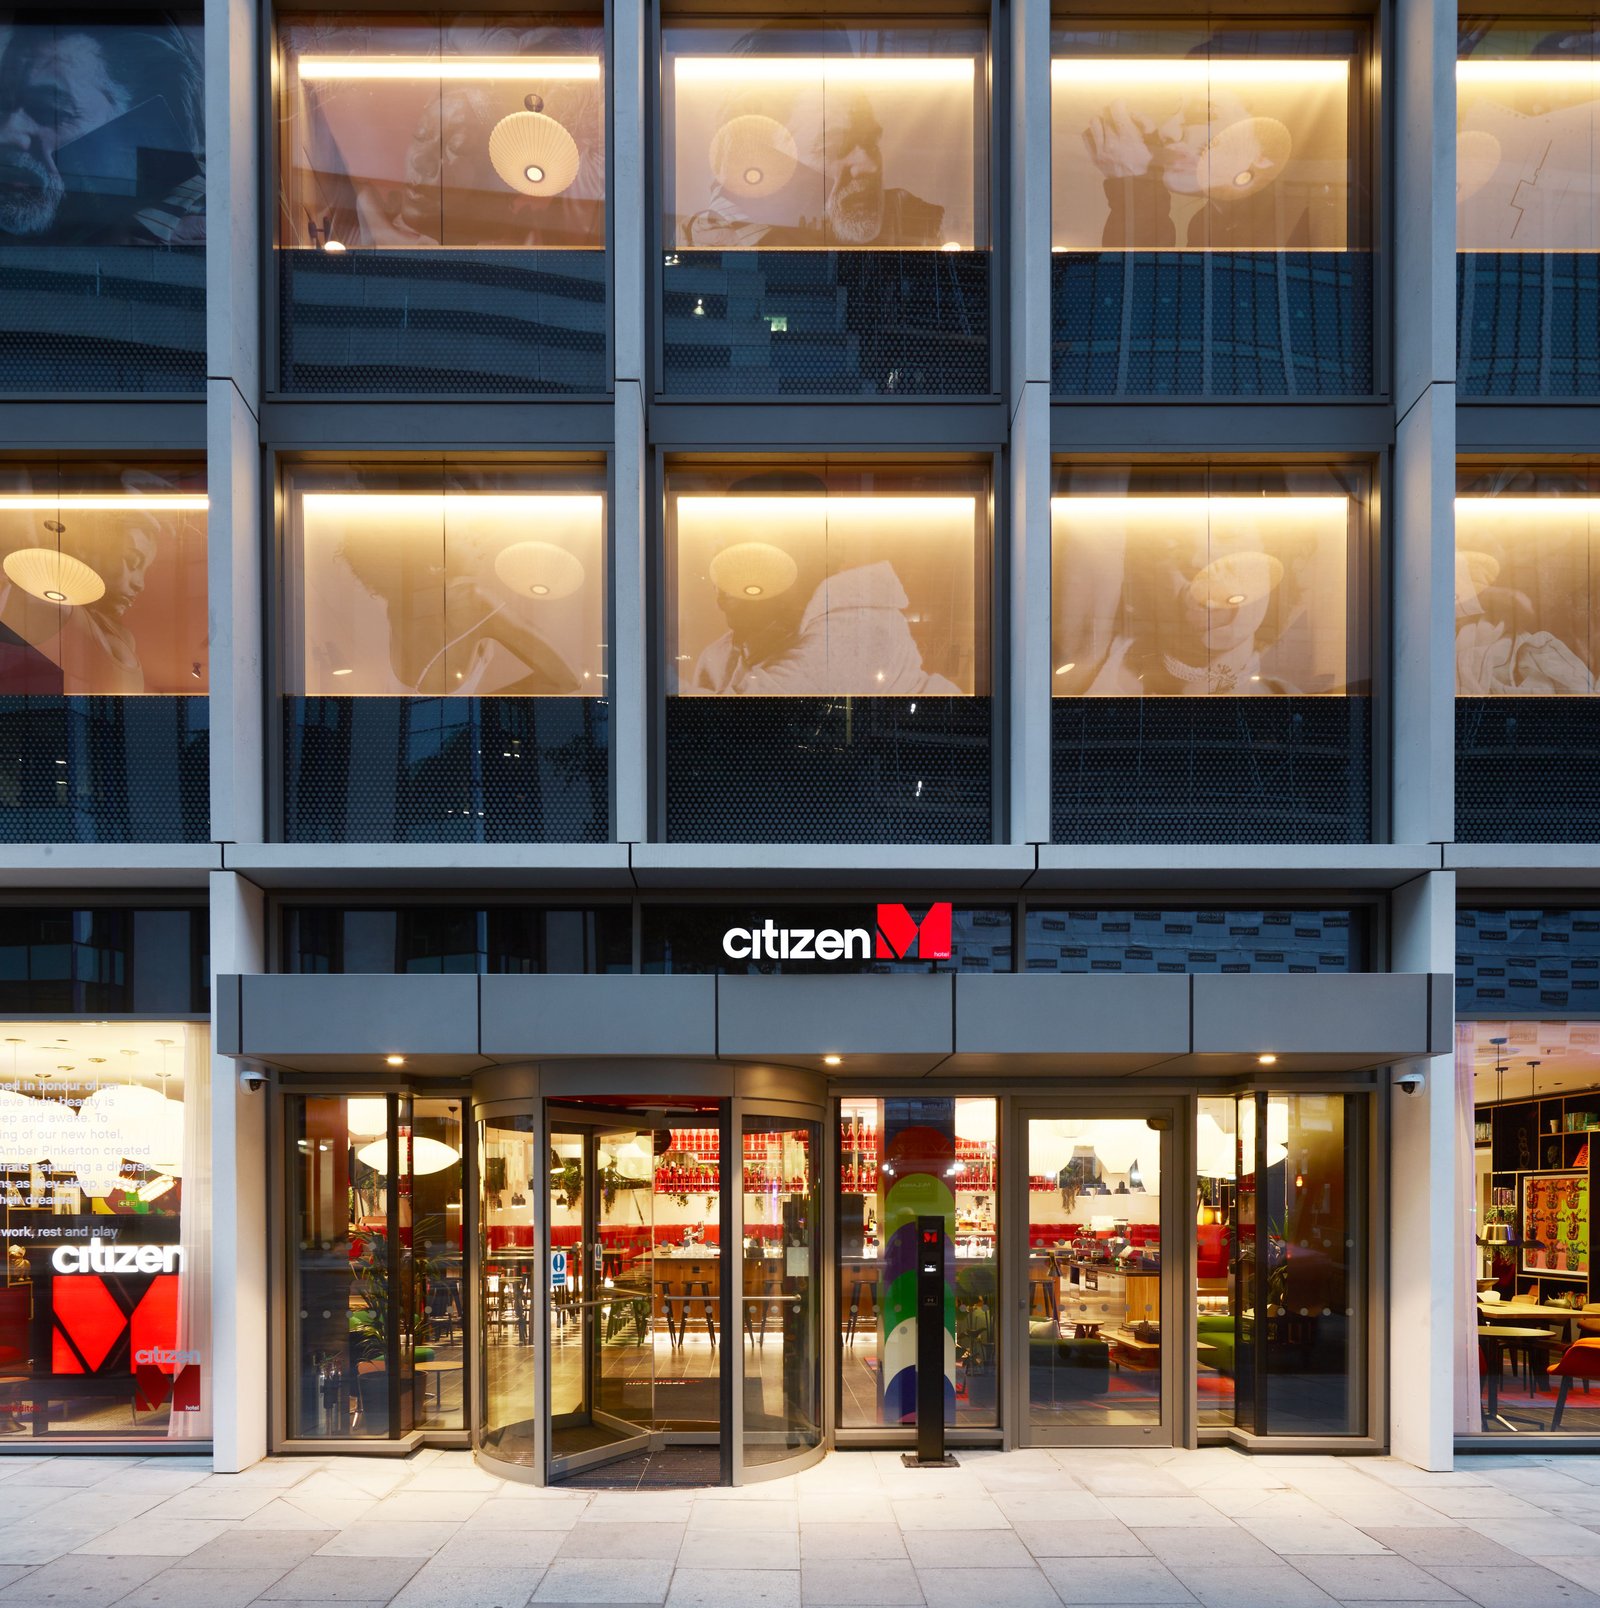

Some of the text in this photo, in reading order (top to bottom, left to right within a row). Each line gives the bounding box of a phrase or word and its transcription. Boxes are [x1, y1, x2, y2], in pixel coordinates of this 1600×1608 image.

[24, 1080, 36, 1091] in
[40, 1080, 81, 1091] honour
[85, 1080, 96, 1091] of
[29, 1096, 55, 1107] their
[59, 1096, 100, 1110] beauty
[105, 1096, 115, 1107] is
[22, 1112, 44, 1123] and
[49, 1112, 91, 1123] awake.
[95, 1113, 108, 1123] To
[22, 1128, 33, 1139] of
[37, 1131, 57, 1139] our
[61, 1131, 87, 1139] new
[42, 1144, 102, 1155] Pinkerton
[104, 1144, 151, 1155] created
[107, 1160, 152, 1171] diverse
[15, 1180, 30, 1188] as
[1, 1226, 119, 1241] work, rest and play
[51, 1238, 183, 1274] citizen
[135, 1346, 201, 1364] citizen
